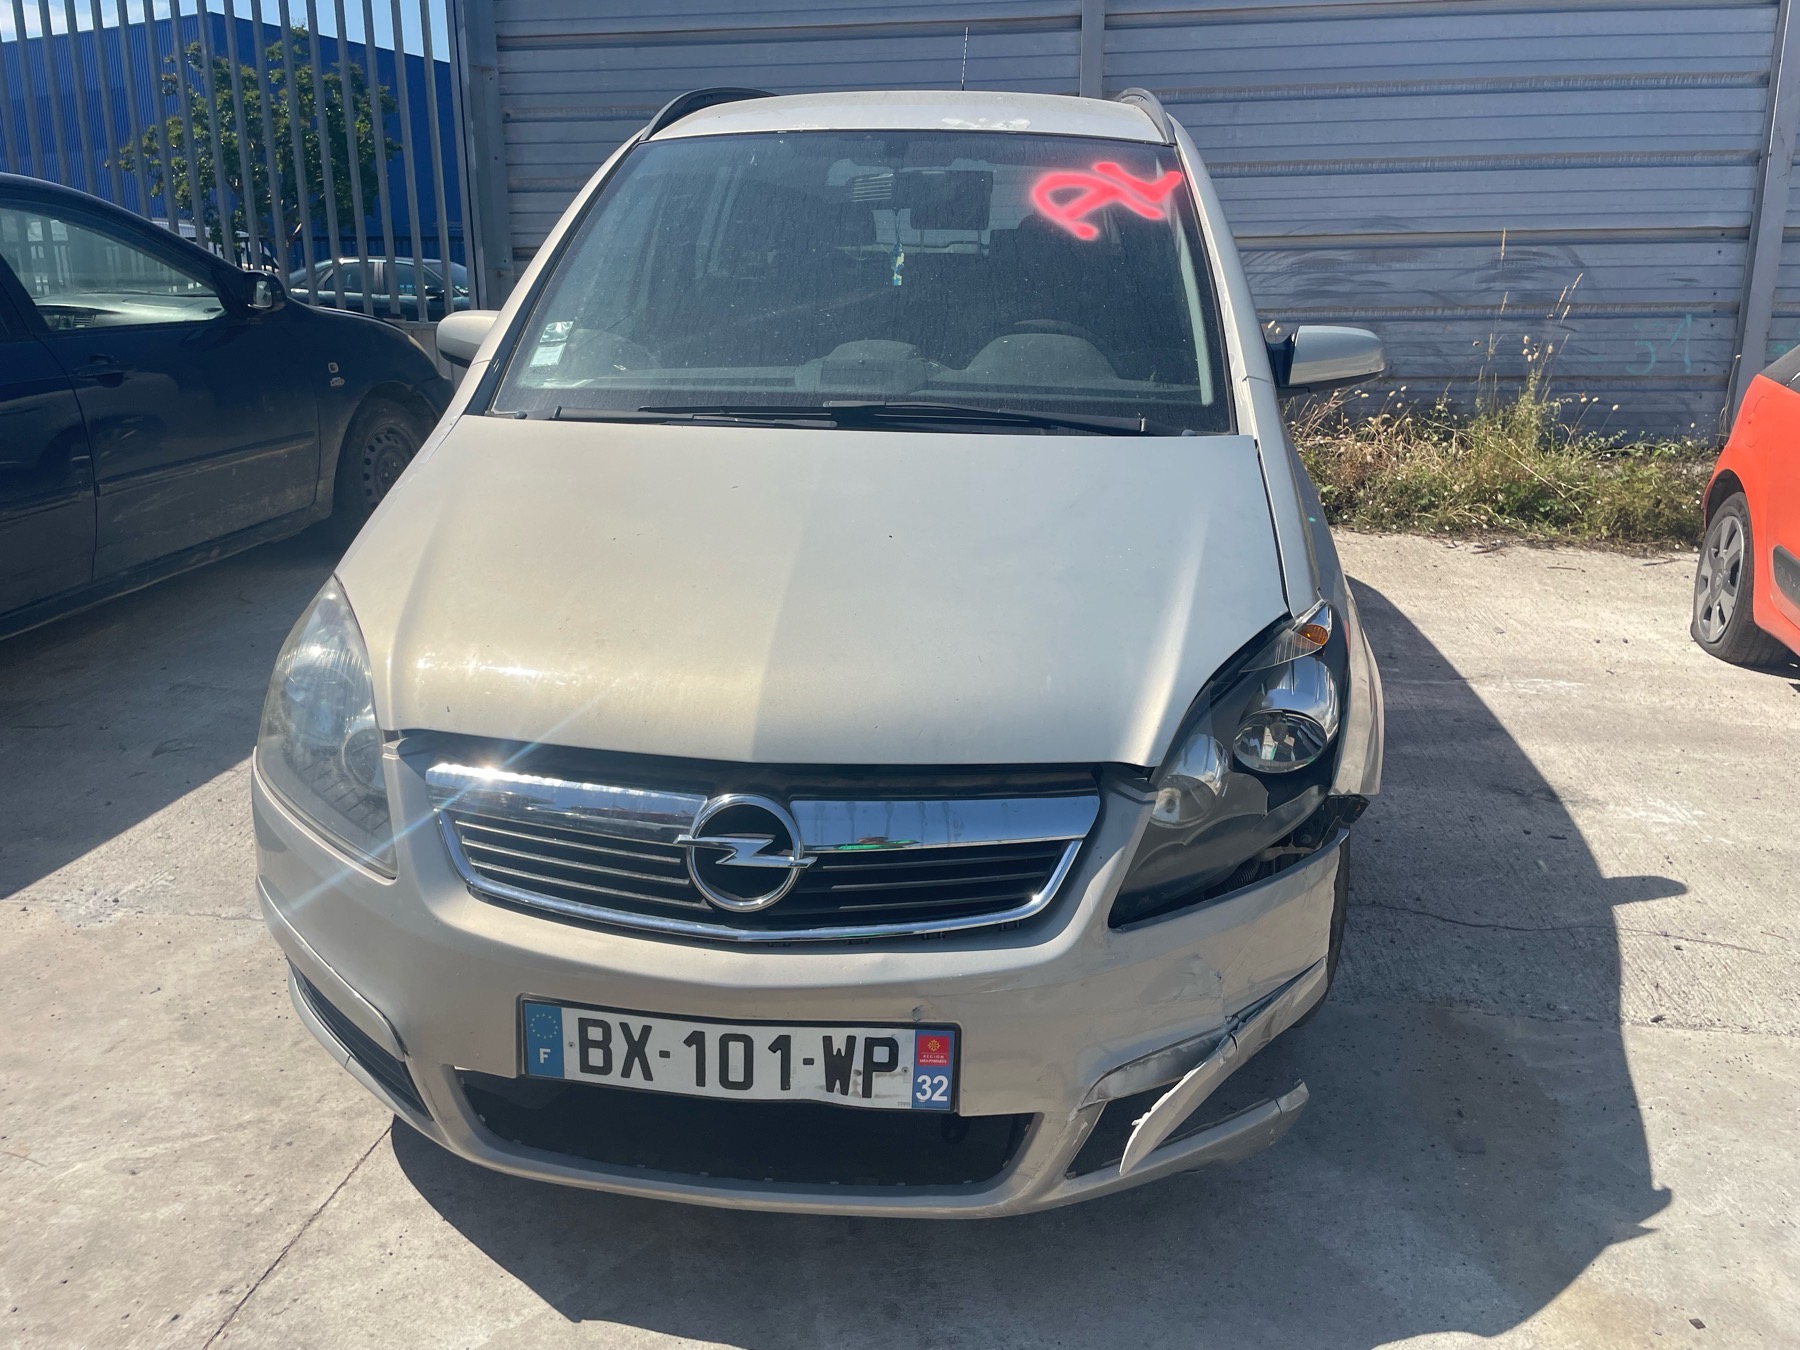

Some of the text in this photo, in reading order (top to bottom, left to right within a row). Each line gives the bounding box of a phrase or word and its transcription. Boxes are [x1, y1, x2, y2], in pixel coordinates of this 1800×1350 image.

[540, 1048, 551, 1063] F
[578, 1017, 899, 1098] BX-101-WP
[916, 1075, 949, 1102] 32
